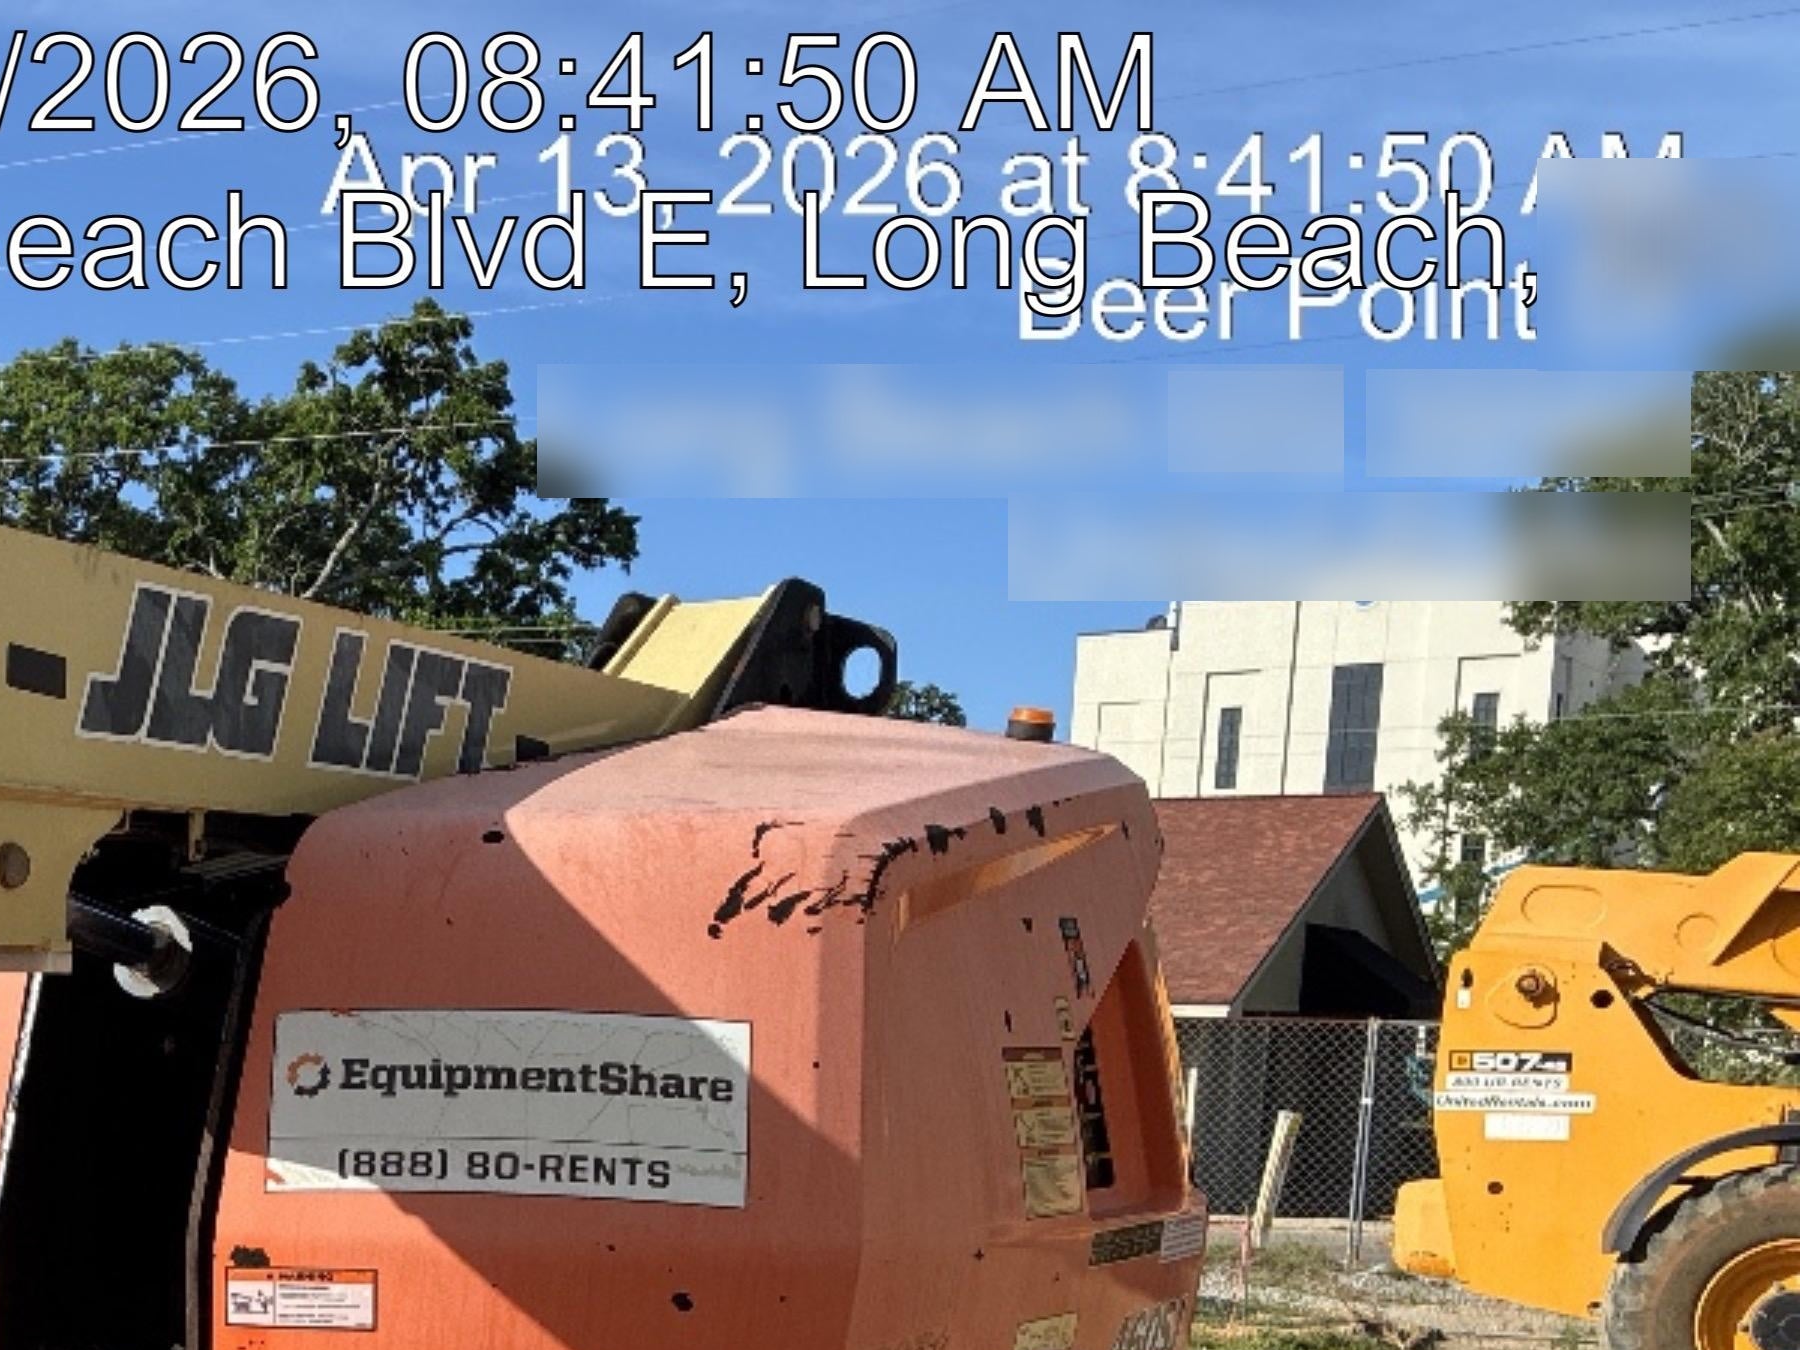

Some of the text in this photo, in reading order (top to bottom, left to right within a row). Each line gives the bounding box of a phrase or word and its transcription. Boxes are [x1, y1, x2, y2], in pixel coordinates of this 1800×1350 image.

[76, 581, 514, 783] JLG LIFT
[338, 1058, 735, 1102] EquipmentShare
[338, 1149, 671, 1189] (888) 80-RENTS
